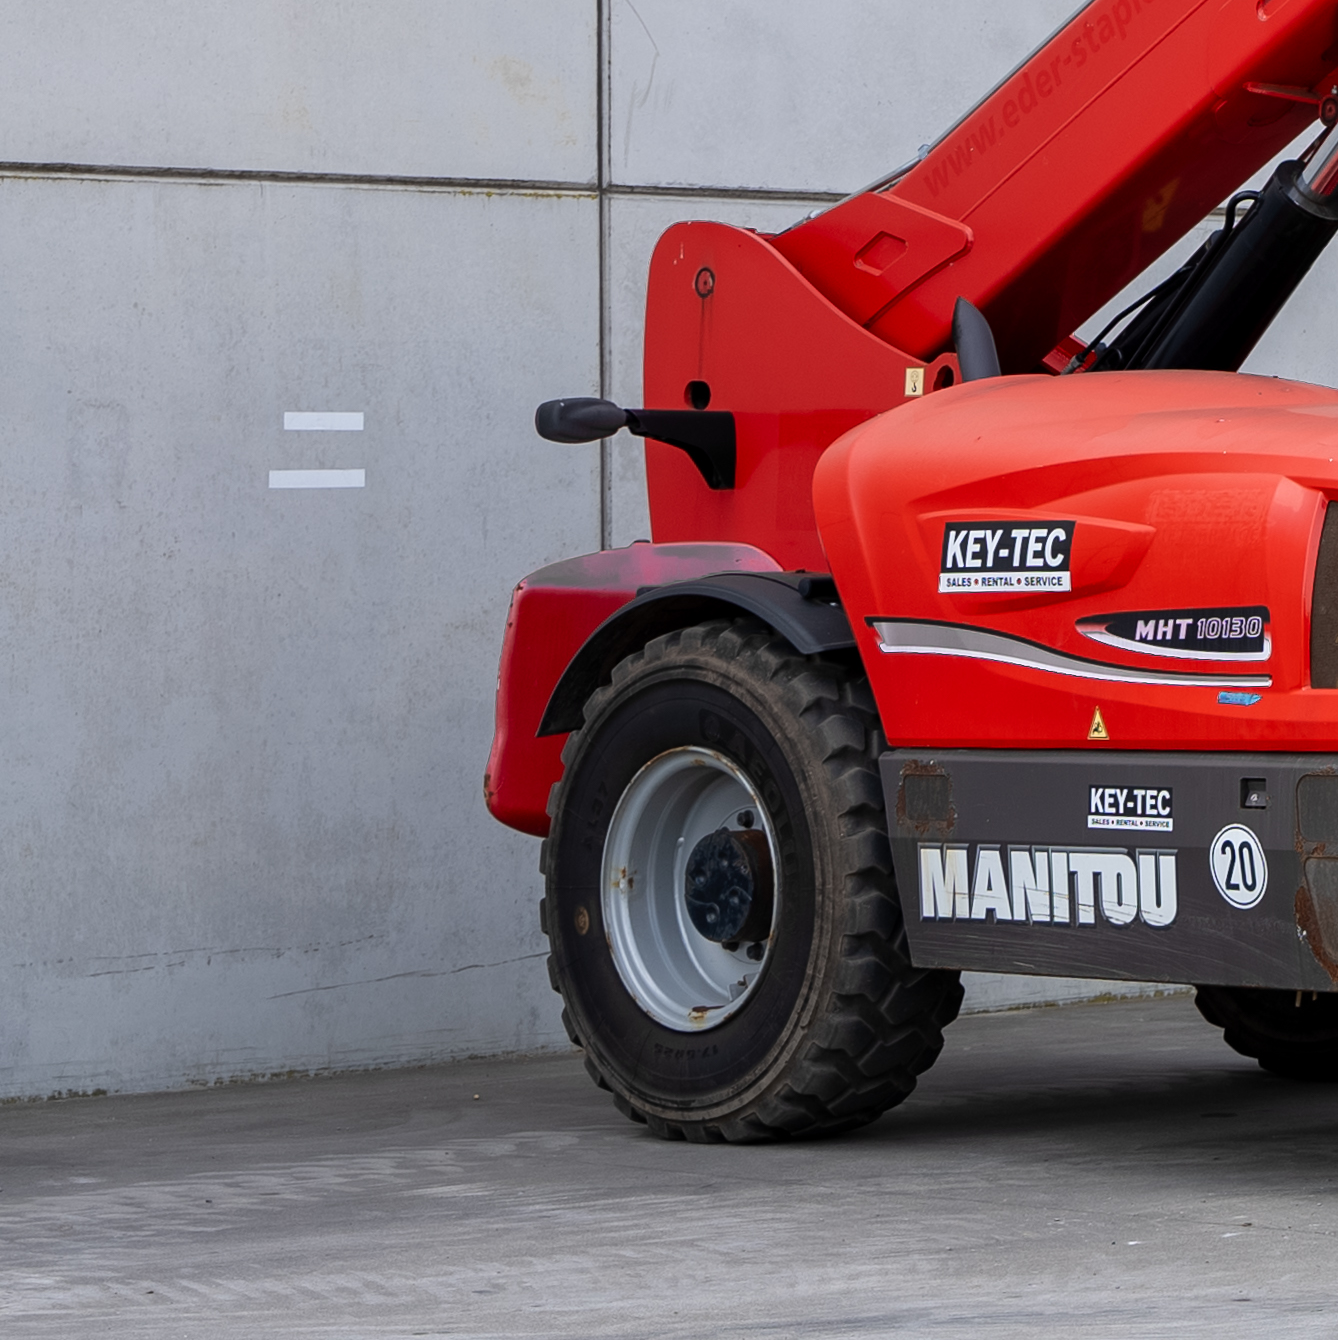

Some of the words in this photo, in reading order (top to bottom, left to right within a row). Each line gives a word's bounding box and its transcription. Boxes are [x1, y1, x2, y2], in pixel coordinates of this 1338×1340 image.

[946, 528, 1067, 569] KEY-TEC
[946, 577, 972, 588] SALES
[981, 577, 1014, 587] RENTAL
[1024, 576, 1063, 587] SERVICE
[1135, 618, 1194, 641] MHT
[1197, 616, 1262, 640] 10130
[1090, 787, 1171, 816] KEY-TEC
[1091, 818, 1110, 827] SALES
[1116, 819, 1138, 827] RENTAL
[1144, 820, 1170, 828] SERVICE
[1220, 839, 1257, 892] 20
[918, 843, 1179, 928] MANITOU
